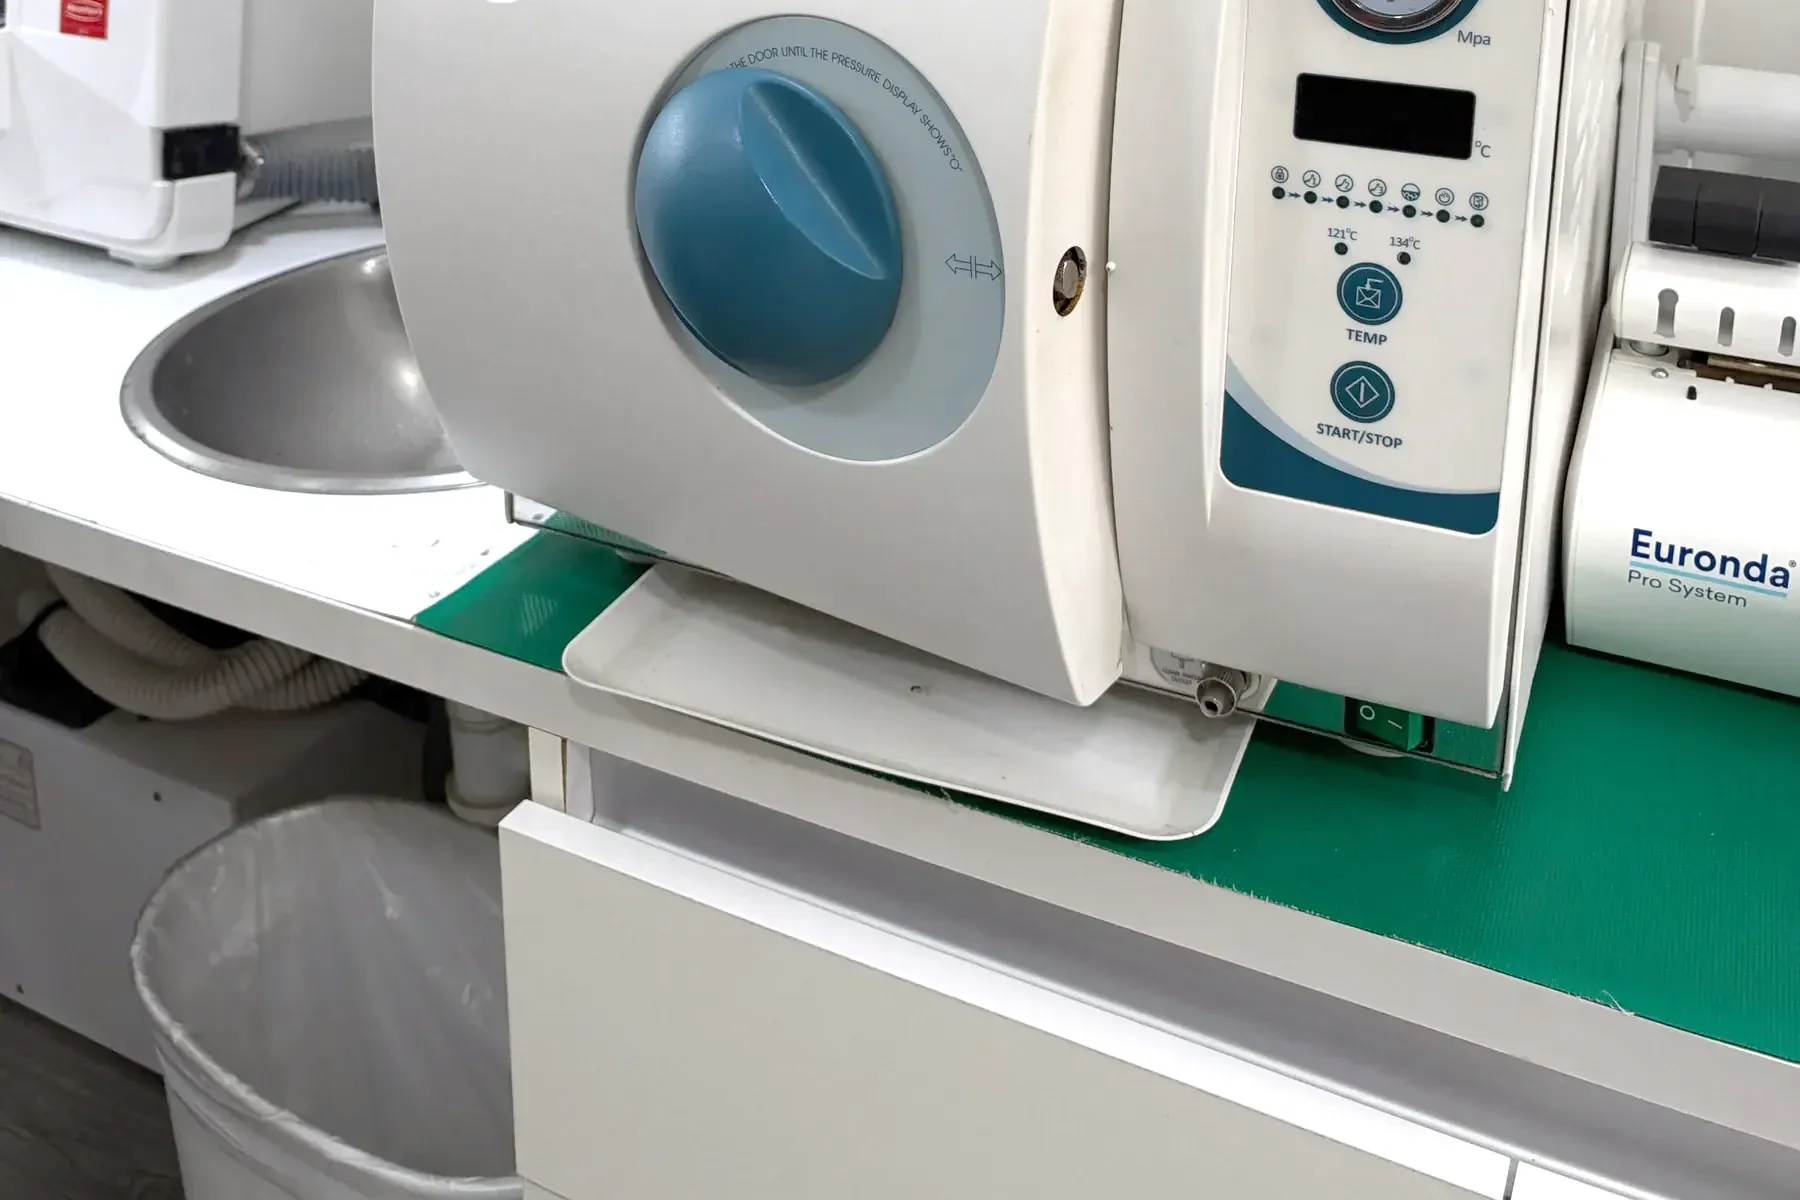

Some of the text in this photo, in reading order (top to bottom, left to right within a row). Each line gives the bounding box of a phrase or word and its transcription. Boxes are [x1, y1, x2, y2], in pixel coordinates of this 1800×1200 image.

[1457, 29, 1491, 48] Mpa
[748, 47, 780, 65] DOOR
[781, 45, 809, 58] UNTIL
[810, 47, 829, 61] THE
[831, 52, 882, 84] PRESSURE
[882, 78, 922, 116] DISPLAY
[919, 114, 953, 156] SHOWS
[1346, 328, 1388, 346] TEMP
[1316, 422, 1403, 449] START/STOP
[1627, 569, 1747, 608] Pro System
